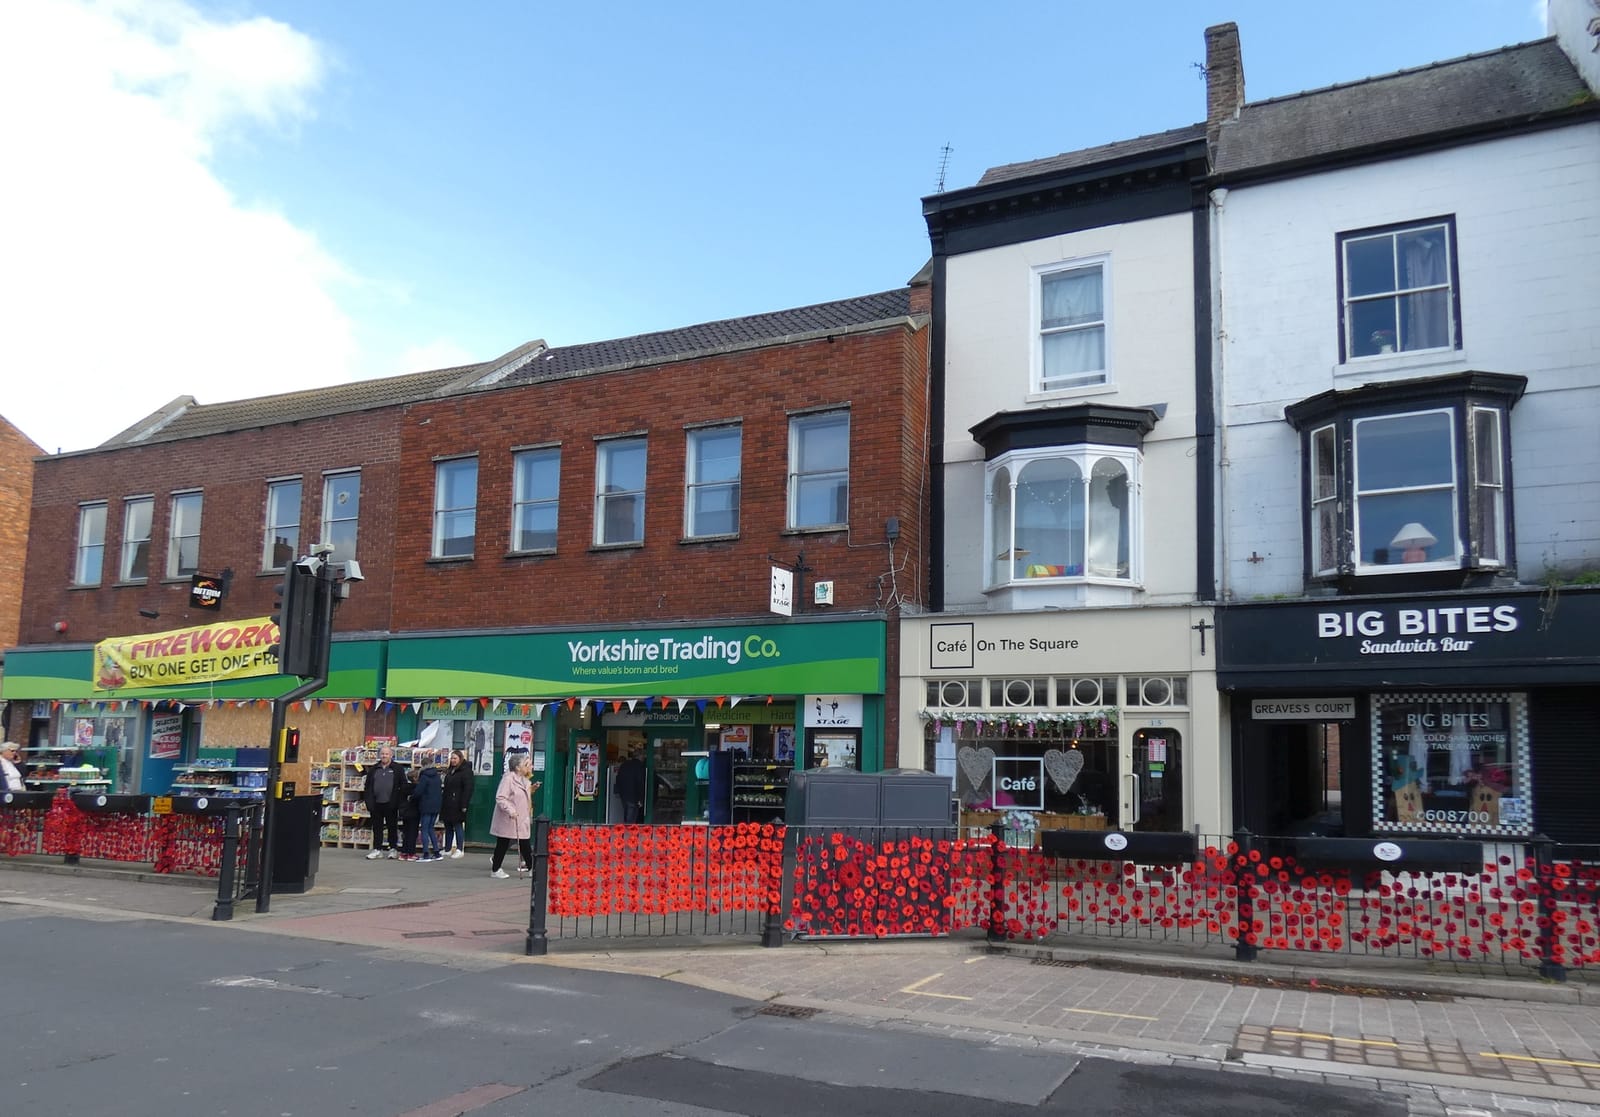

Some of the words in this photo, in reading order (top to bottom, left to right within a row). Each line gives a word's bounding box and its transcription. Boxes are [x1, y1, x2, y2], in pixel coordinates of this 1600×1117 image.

[1318, 610, 1385, 638] BIG
[1398, 605, 1518, 635] BITES
[744, 635, 781, 658] Co.
[936, 639, 967, 653] Café
[976, 640, 996, 651] On
[1000, 639, 1025, 651] The
[1029, 638, 1079, 652] Square
[1360, 639, 1439, 654] Sandwich
[1440, 636, 1474, 652] Bar
[130, 663, 155, 679] BUY
[157, 661, 186, 676] ONE
[190, 658, 217, 674] GET
[221, 654, 249, 671] ONE
[572, 667, 597, 676] Where
[598, 666, 623, 675] value's
[624, 665, 642, 675] born
[643, 665, 658, 674] and
[659, 664, 679, 674] bred
[1315, 703, 1353, 713] COURT
[1407, 713, 1435, 727] BIG
[1441, 713, 1489, 727] BITES
[1392, 734, 1411, 742] HOT
[1423, 734, 1445, 742] COLD
[1000, 776, 1036, 791] Café
